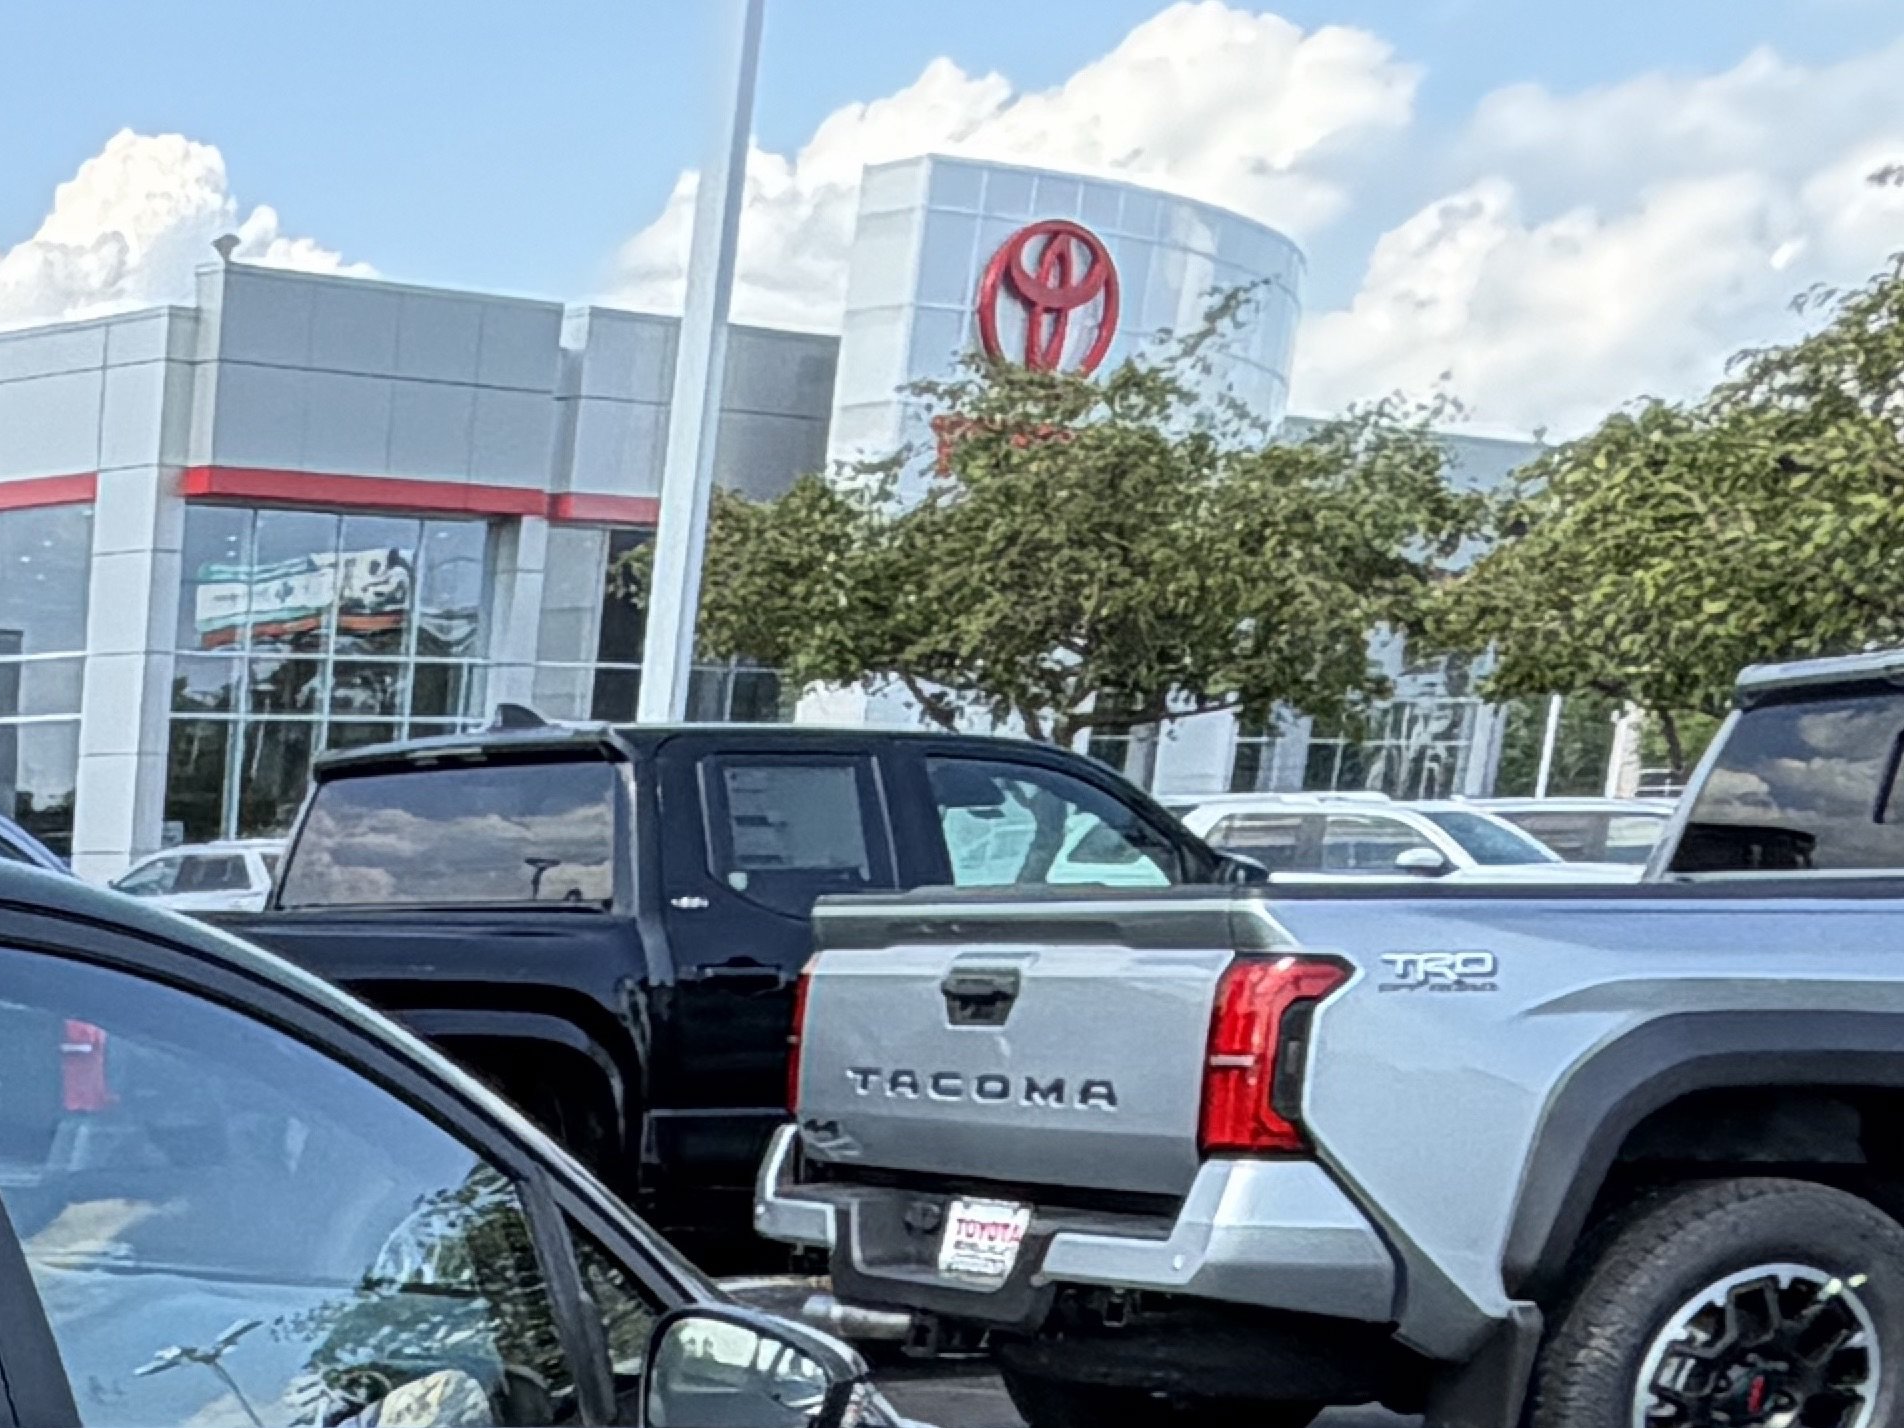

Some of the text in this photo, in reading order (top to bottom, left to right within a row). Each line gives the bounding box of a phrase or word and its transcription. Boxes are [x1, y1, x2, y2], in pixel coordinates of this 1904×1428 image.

[1380, 951, 1496, 982] TRD
[846, 1066, 1119, 1111] TACOMA
[956, 1218, 1022, 1243] TOYOTA
